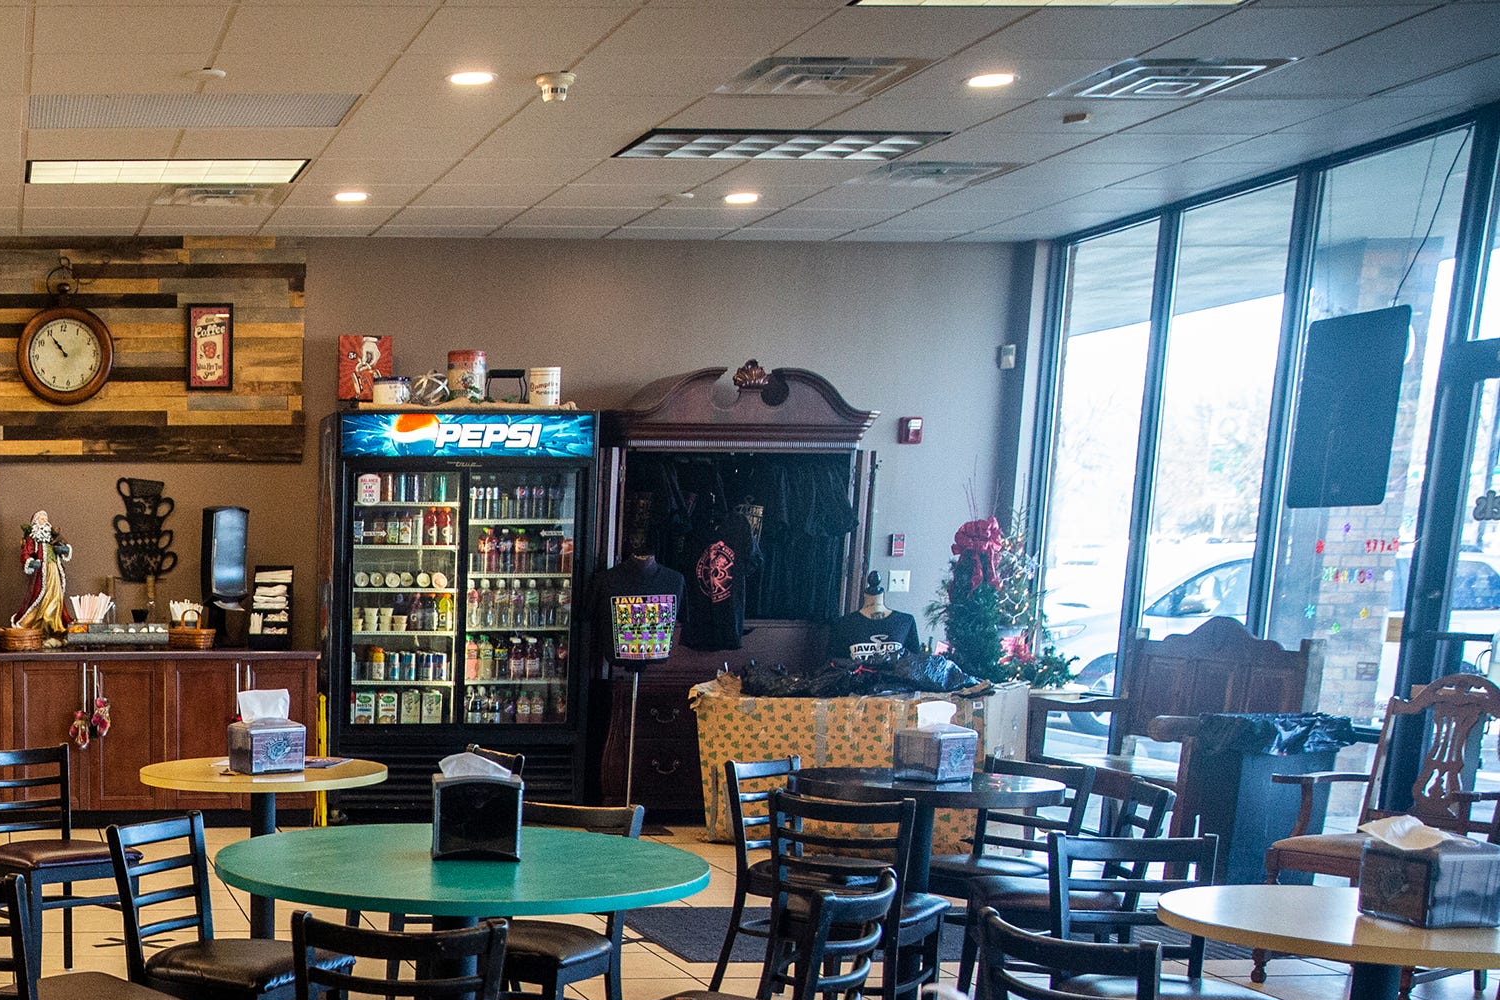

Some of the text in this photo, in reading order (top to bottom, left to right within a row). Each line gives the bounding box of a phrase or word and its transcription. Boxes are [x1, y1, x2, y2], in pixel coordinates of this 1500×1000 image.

[195, 323, 226, 338] Coffee
[434, 423, 543, 449] PEPSI
[854, 644, 877, 653] JAVA
